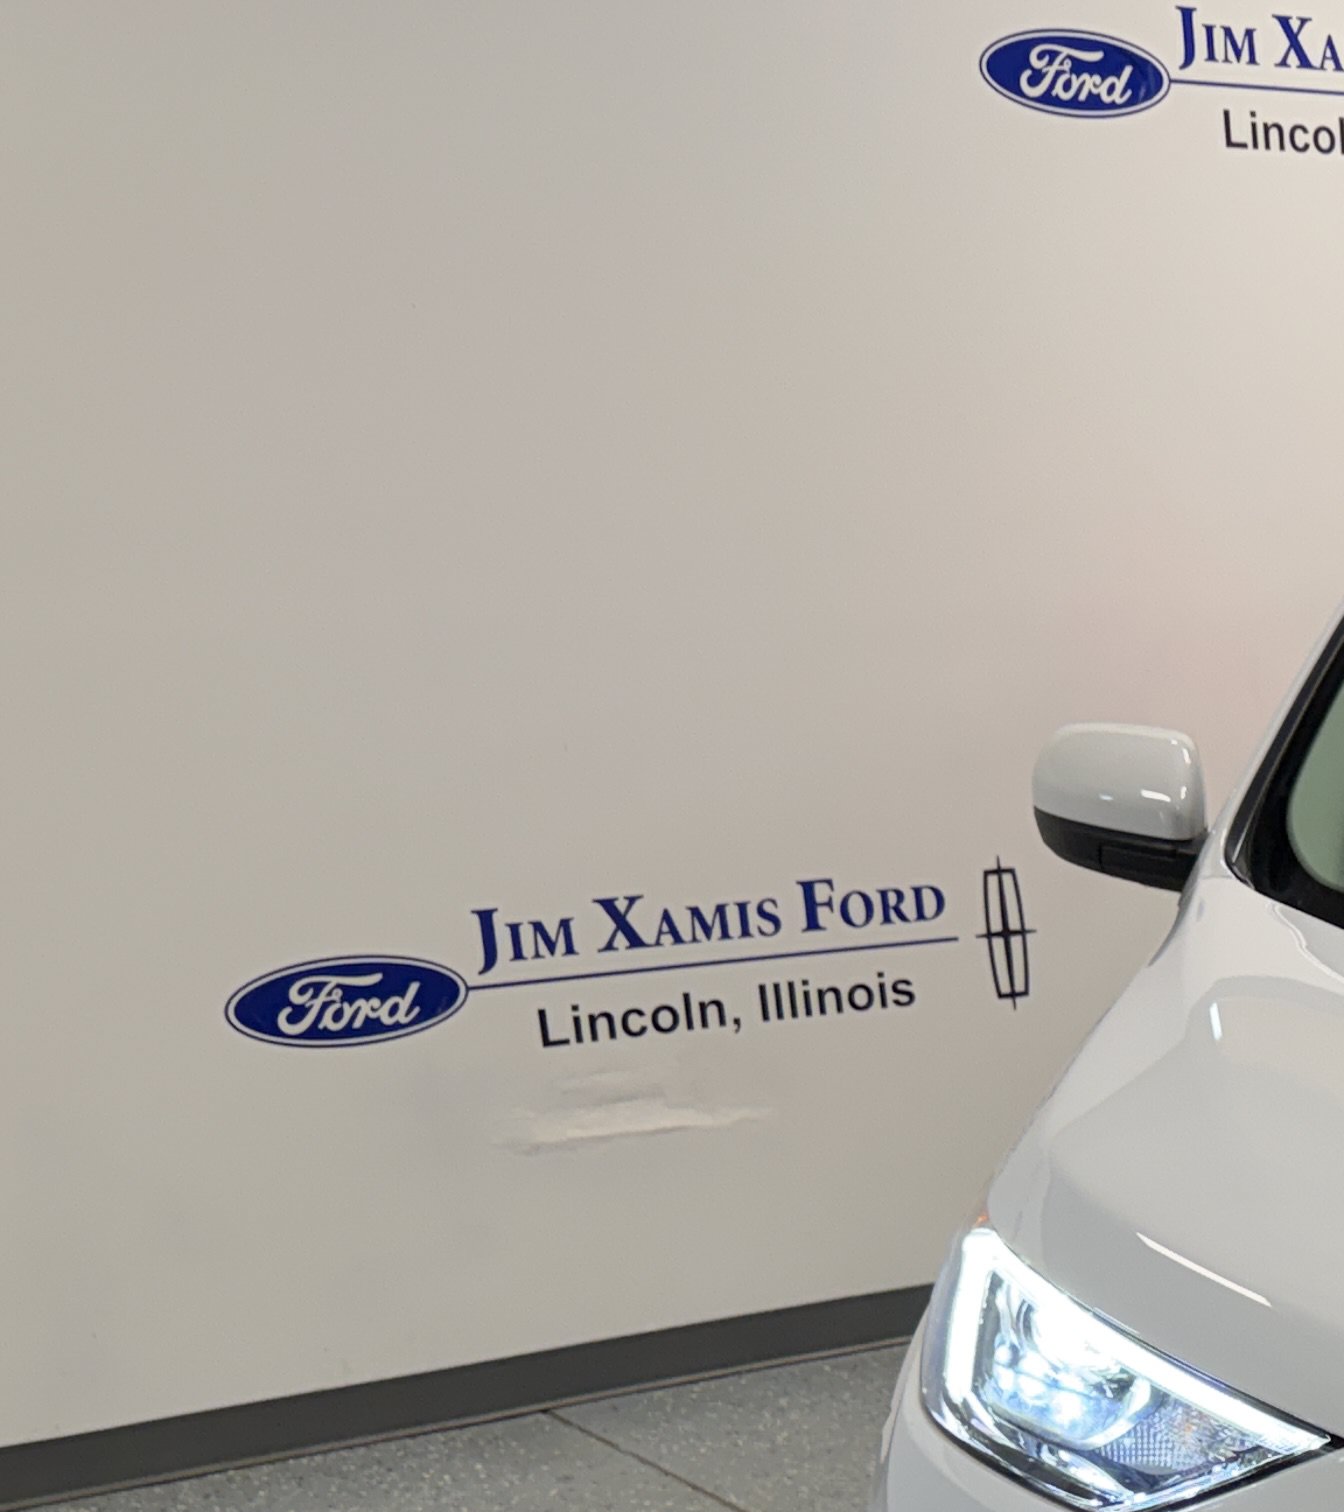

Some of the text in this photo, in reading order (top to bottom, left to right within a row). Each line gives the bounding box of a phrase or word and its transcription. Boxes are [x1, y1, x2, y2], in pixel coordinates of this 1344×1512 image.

[1176, 6, 1259, 70] JIM
[1018, 46, 1132, 106] Ford
[470, 878, 946, 974] JIM XAMIS FORD
[276, 974, 420, 1036] Ford
[537, 971, 916, 1048] Lincoln, Illinois
